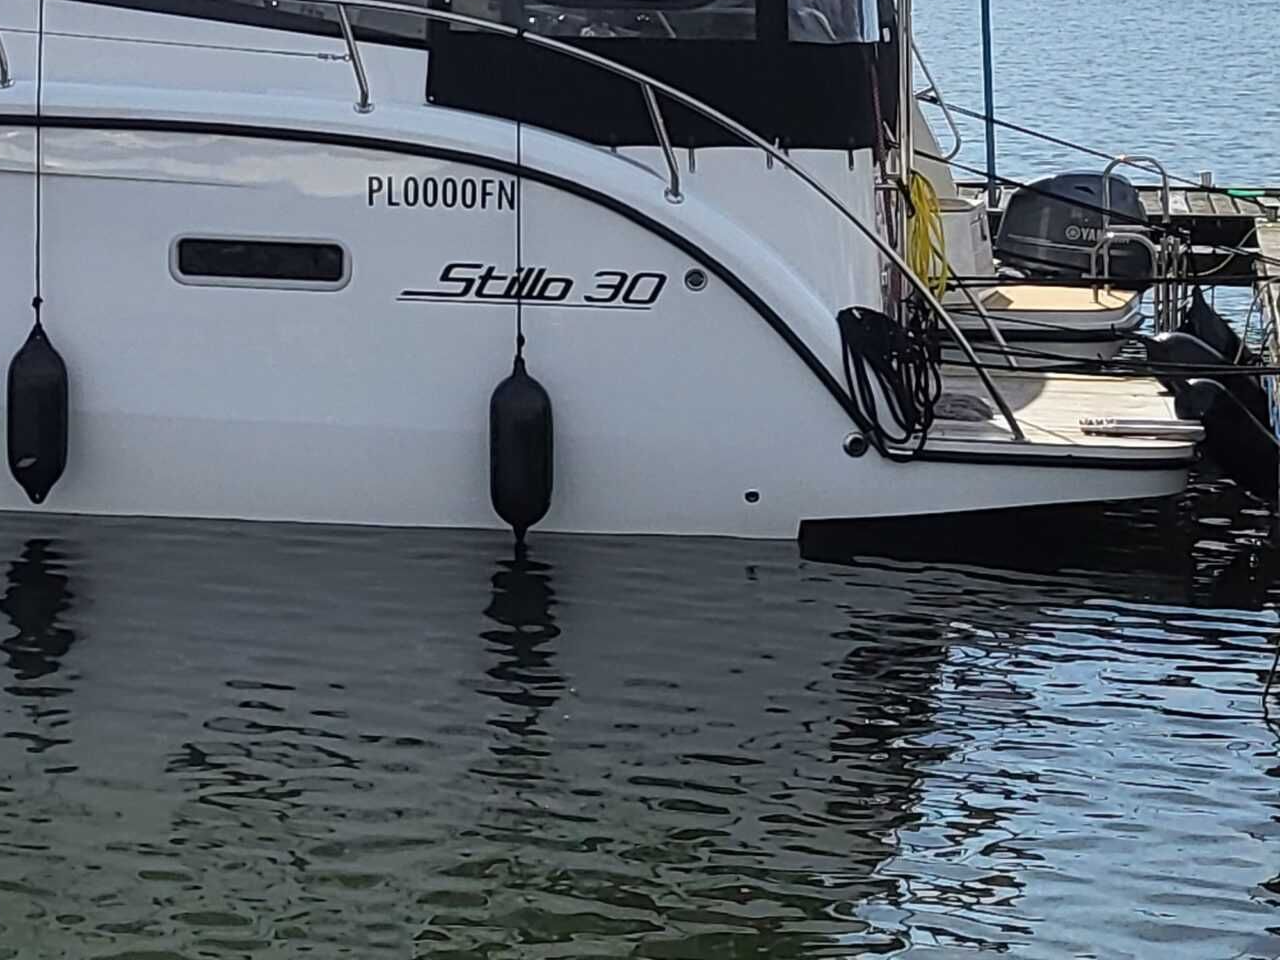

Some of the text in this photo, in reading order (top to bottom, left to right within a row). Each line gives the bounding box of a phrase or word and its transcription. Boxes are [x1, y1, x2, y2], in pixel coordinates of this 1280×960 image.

[368, 176, 516, 210] PL0000FN
[400, 263, 667, 304] Stillo 30
